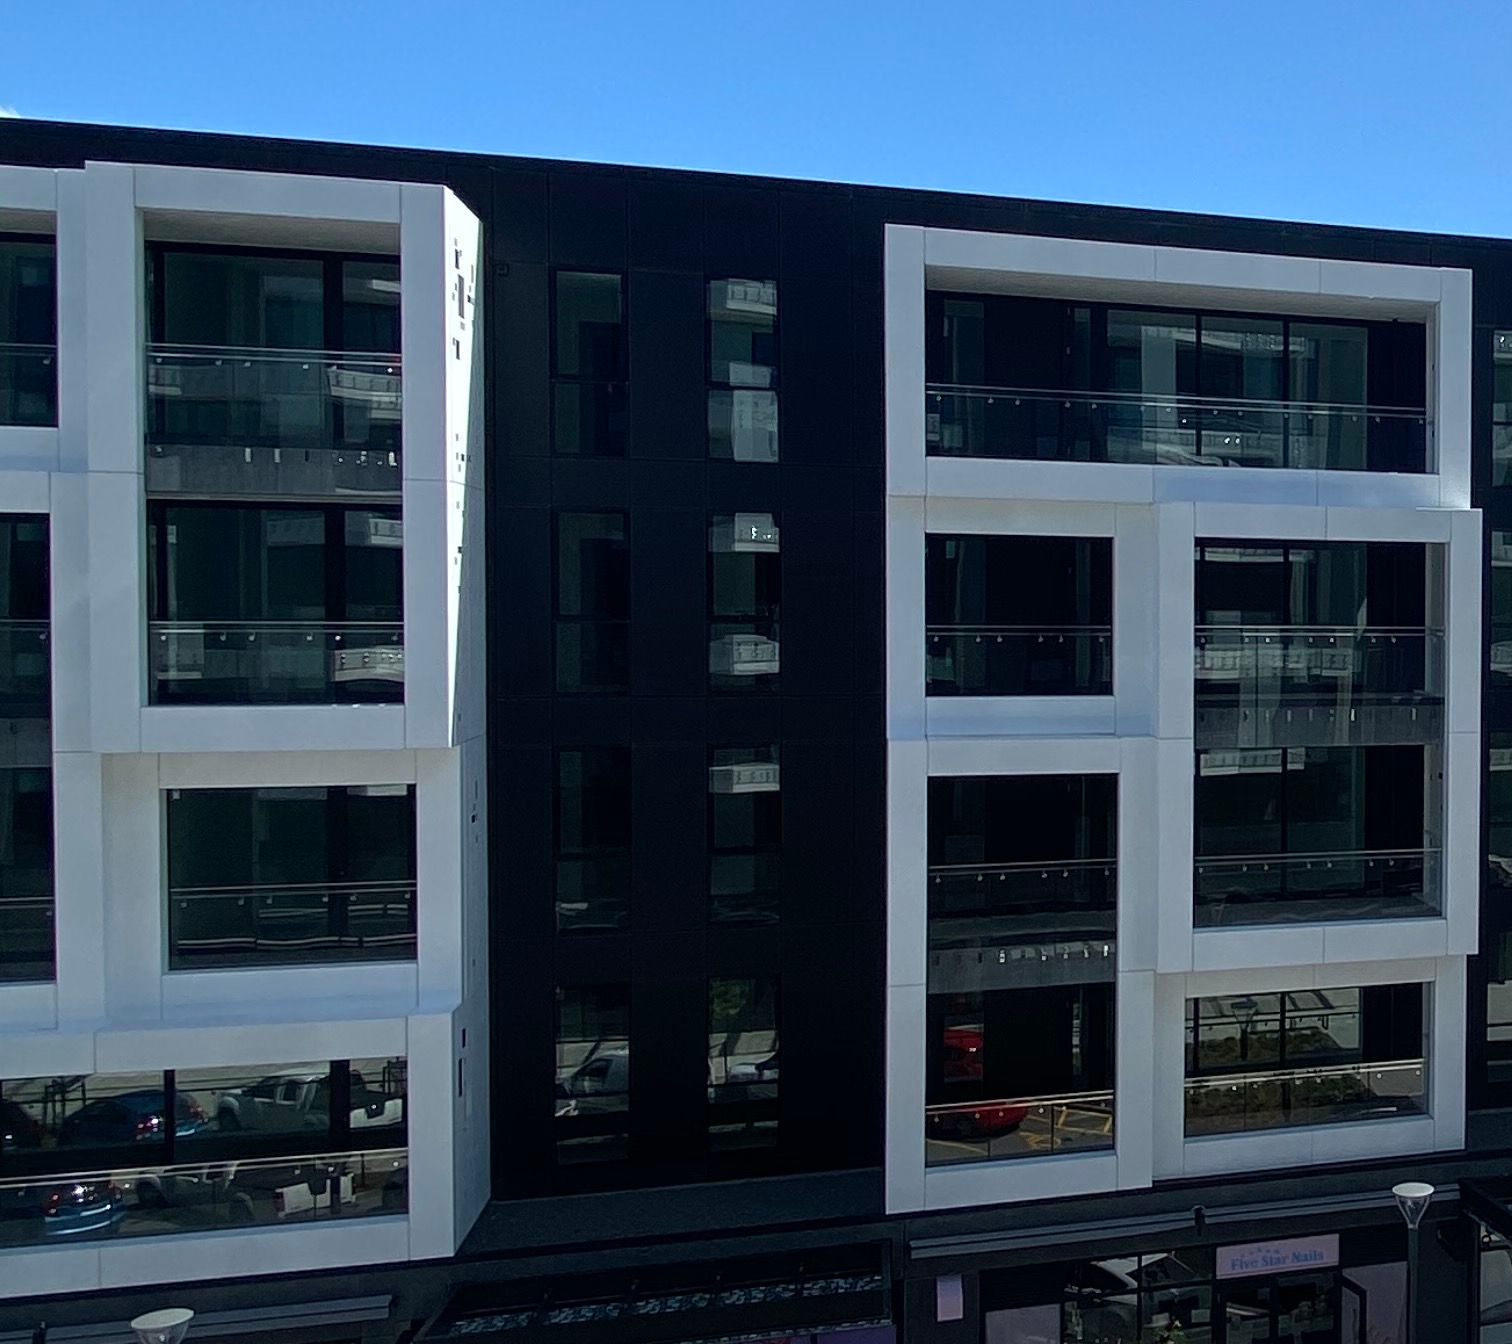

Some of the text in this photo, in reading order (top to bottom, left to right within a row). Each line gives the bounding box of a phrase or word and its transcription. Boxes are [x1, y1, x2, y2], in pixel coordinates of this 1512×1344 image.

[1231, 1249, 1324, 1271] Five Star Nails
